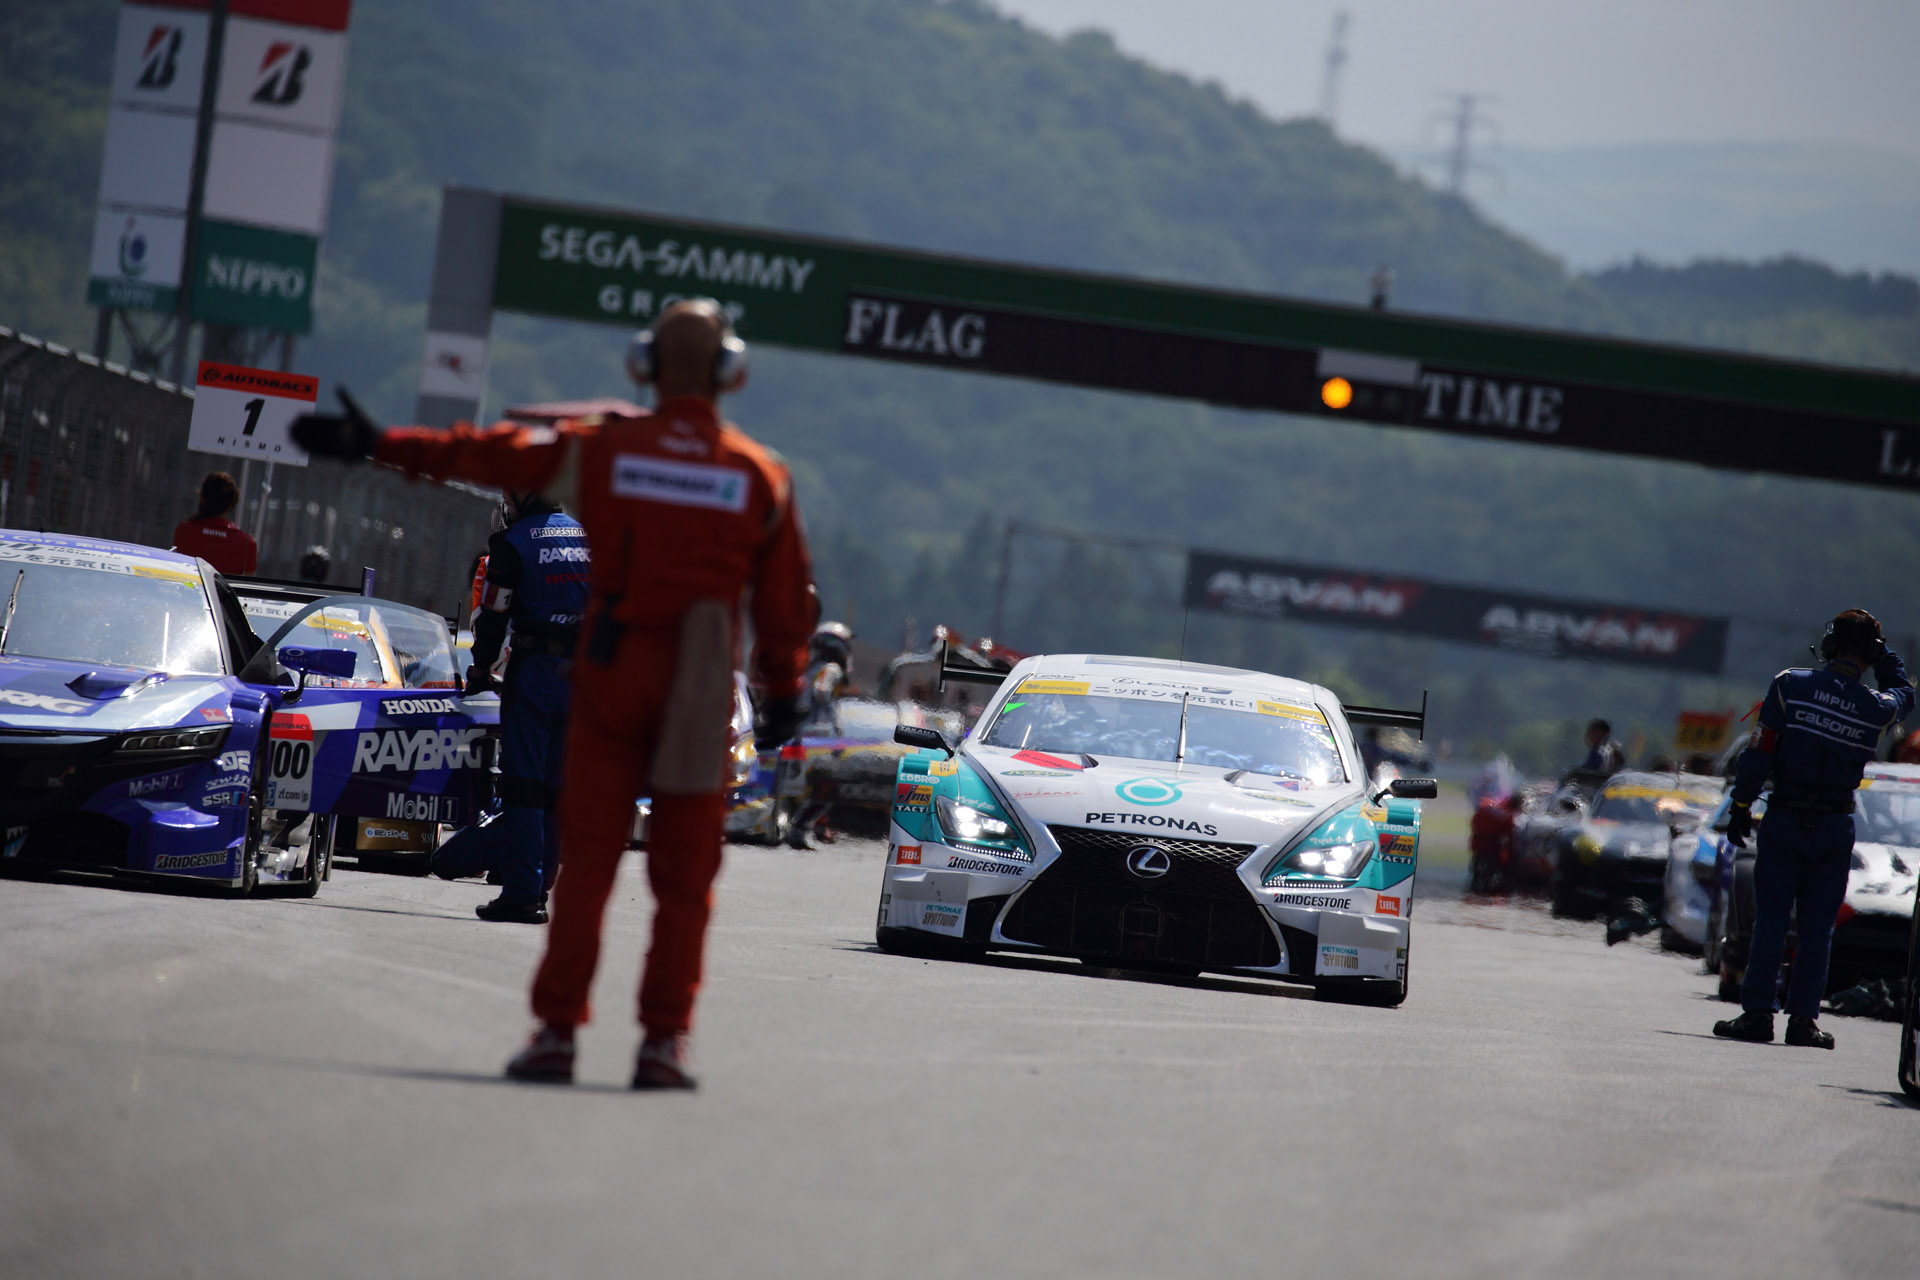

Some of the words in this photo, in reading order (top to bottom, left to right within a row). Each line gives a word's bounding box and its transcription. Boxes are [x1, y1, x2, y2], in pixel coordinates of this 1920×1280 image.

[208, 253, 306, 299] NIPPO
[598, 283, 746, 326] GRP
[846, 299, 987, 359] FLAG
[222, 372, 313, 395] AUTOBACS
[1420, 371, 1565, 433] TIME
[243, 398, 266, 437] 1
[1877, 428, 1920, 476] L
[1207, 570, 1403, 617] ADVAN
[1481, 604, 1681, 654] ADVAN
[1136, 680, 1199, 691] LEXUS
[382, 699, 455, 715] HONDA
[1813, 690, 1860, 714] IMPUL
[351, 728, 487, 774] RAYBRIG
[128, 775, 168, 797] Mobil
[202, 792, 231, 807] SSR
[386, 791, 439, 821] Mobil
[896, 805, 929, 813] TACTI
[1086, 813, 1218, 837] PETRONAS
[156, 850, 228, 869] BRIDGESTONE
[901, 849, 920, 861] JBL
[1379, 854, 1412, 865] TACTI
[948, 856, 1026, 877] BRIDGESTONE
[926, 904, 963, 915] PETRONAS
[1273, 893, 1352, 910] BRIDGESTONE
[1379, 900, 1398, 912] JBL
[1321, 946, 1358, 956] PETRONAS
